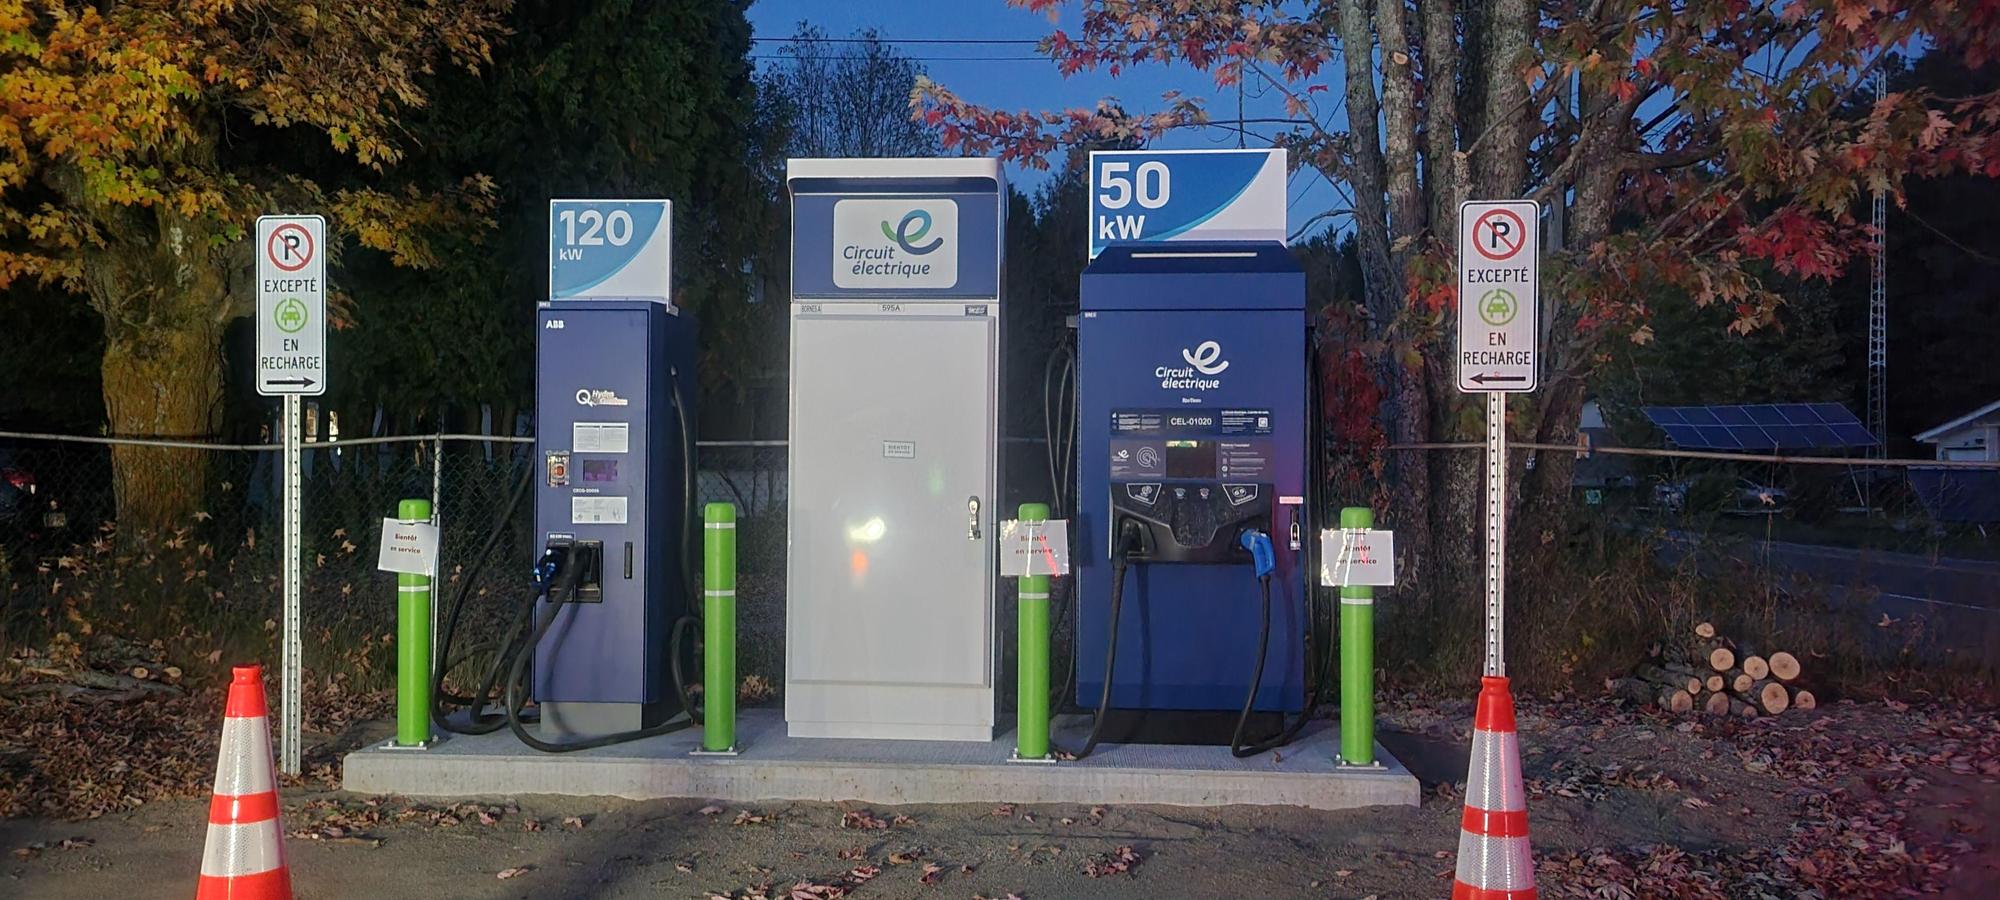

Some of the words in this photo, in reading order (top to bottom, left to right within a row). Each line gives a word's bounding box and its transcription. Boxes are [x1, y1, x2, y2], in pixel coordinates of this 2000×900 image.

[1099, 161, 1170, 209] 50
[560, 209, 634, 246] 120
[1099, 215, 1145, 240] kW
[1491, 222, 1510, 248] P
[284, 236, 300, 260] P
[560, 248, 583, 261] kW
[843, 246, 895, 259] Circuit
[852, 260, 930, 279] électrique
[1468, 266, 1529, 283] EXCEPTÉ
[264, 277, 317, 293] EXCEPTÉ
[546, 320, 564, 329] ABB
[283, 338, 299, 351] EN
[1489, 332, 1507, 346] EN
[261, 357, 320, 369] RECHARGE
[1463, 351, 1531, 365] RECHARGE
[1155, 366, 1194, 378] Circuit
[1162, 377, 1220, 391] électrique
[1170, 417, 1212, 426] CEL-01020
[395, 533, 417, 541] Bientôt
